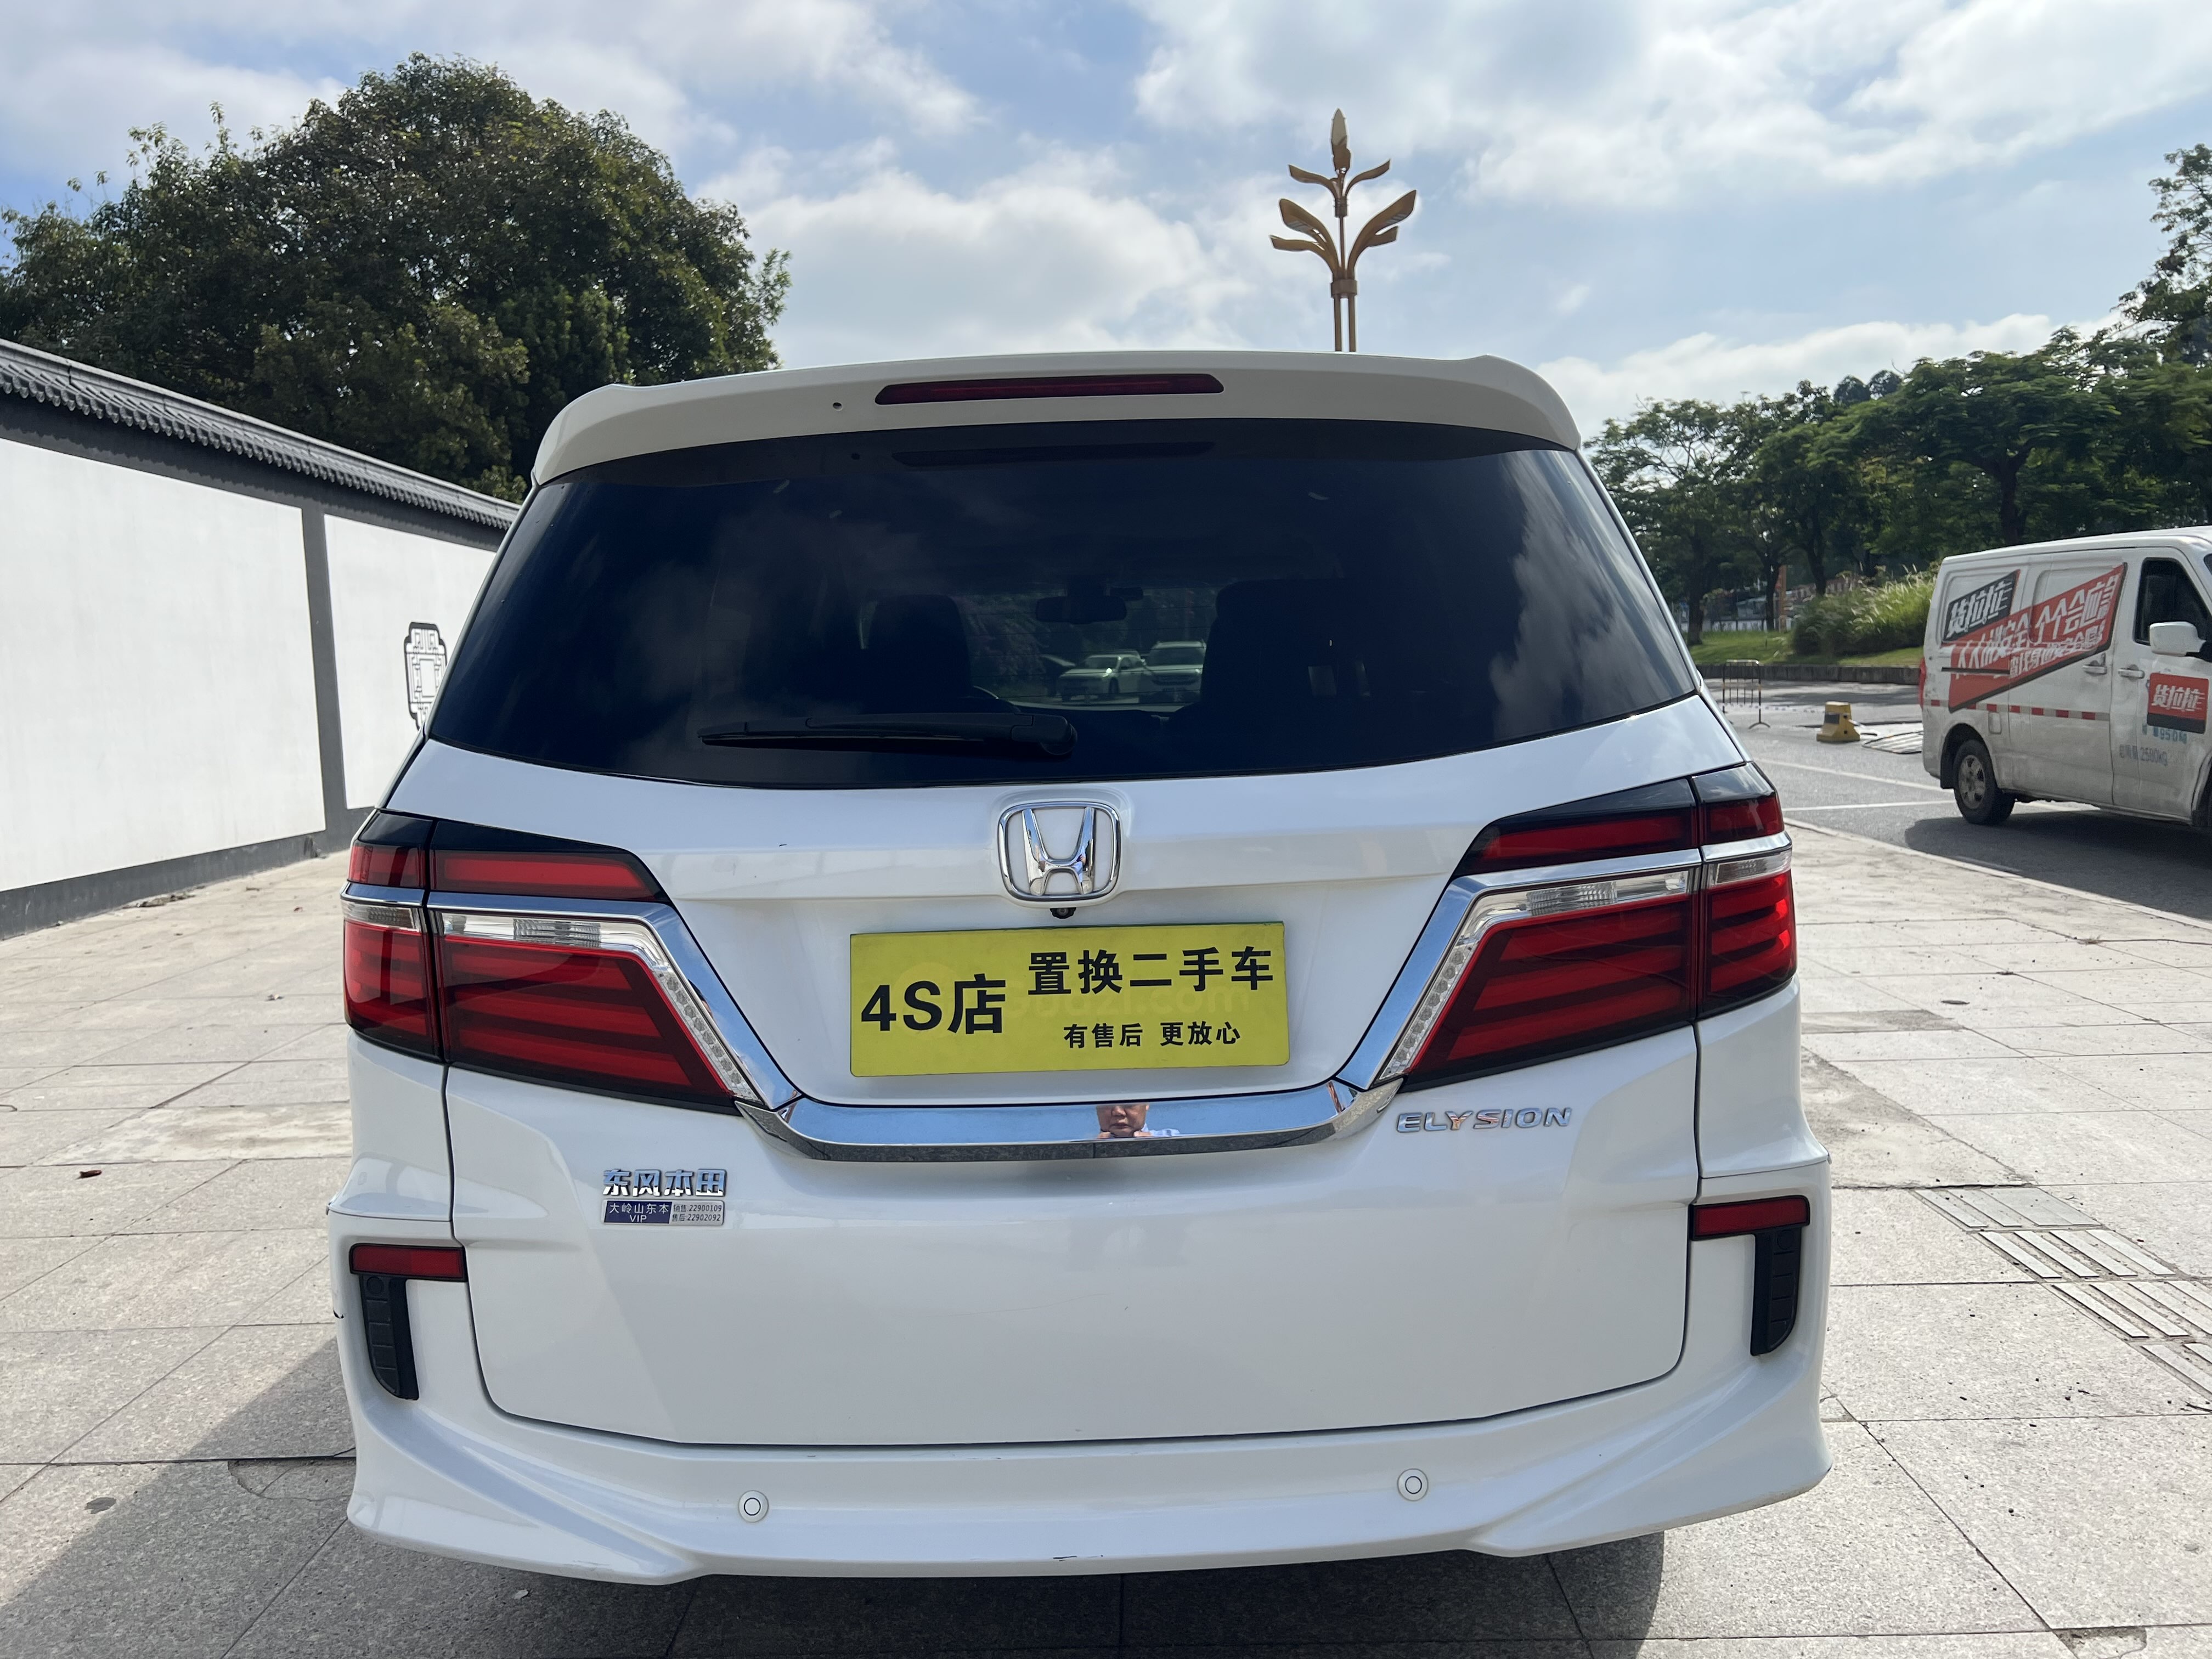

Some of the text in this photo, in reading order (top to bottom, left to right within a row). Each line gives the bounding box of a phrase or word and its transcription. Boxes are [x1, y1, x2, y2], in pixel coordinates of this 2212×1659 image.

[1946, 581, 2012, 639] 货拉拉
[2152, 684, 2205, 712] 货拉拉
[1028, 946, 1273, 995] 置换二手车
[861, 974, 1006, 1034] 4S店
[1064, 1021, 1240, 1048] 有售后 更放心
[1397, 1107, 1572, 1132] ELYSION
[602, 1169, 727, 1197] 东风本田
[610, 1203, 669, 1214] 大岭山东本
